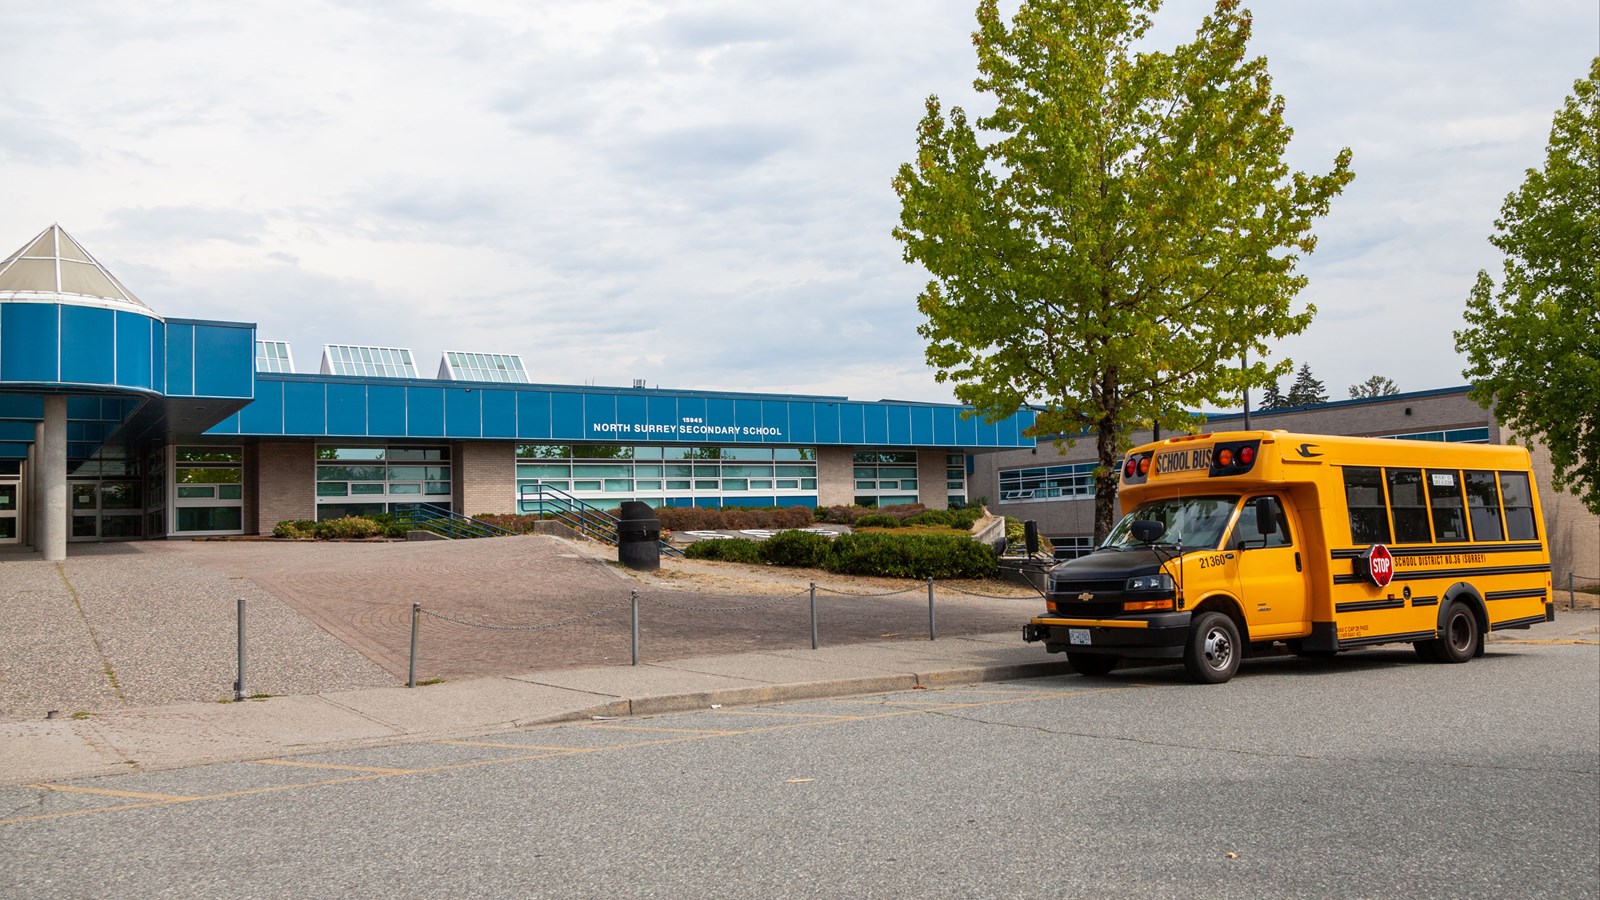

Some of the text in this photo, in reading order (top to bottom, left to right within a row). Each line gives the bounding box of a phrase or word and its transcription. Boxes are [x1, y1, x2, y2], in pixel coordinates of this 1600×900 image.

[593, 423, 782, 436] NORTH SURREY SECONDARY SCHOOL
[1156, 448, 1212, 474] SCHOOL BUS
[1199, 554, 1226, 569] 21360
[1373, 557, 1390, 573] STOP
[1394, 556, 1417, 568] SCHOOL
[1418, 555, 1443, 567] DISTRICT
